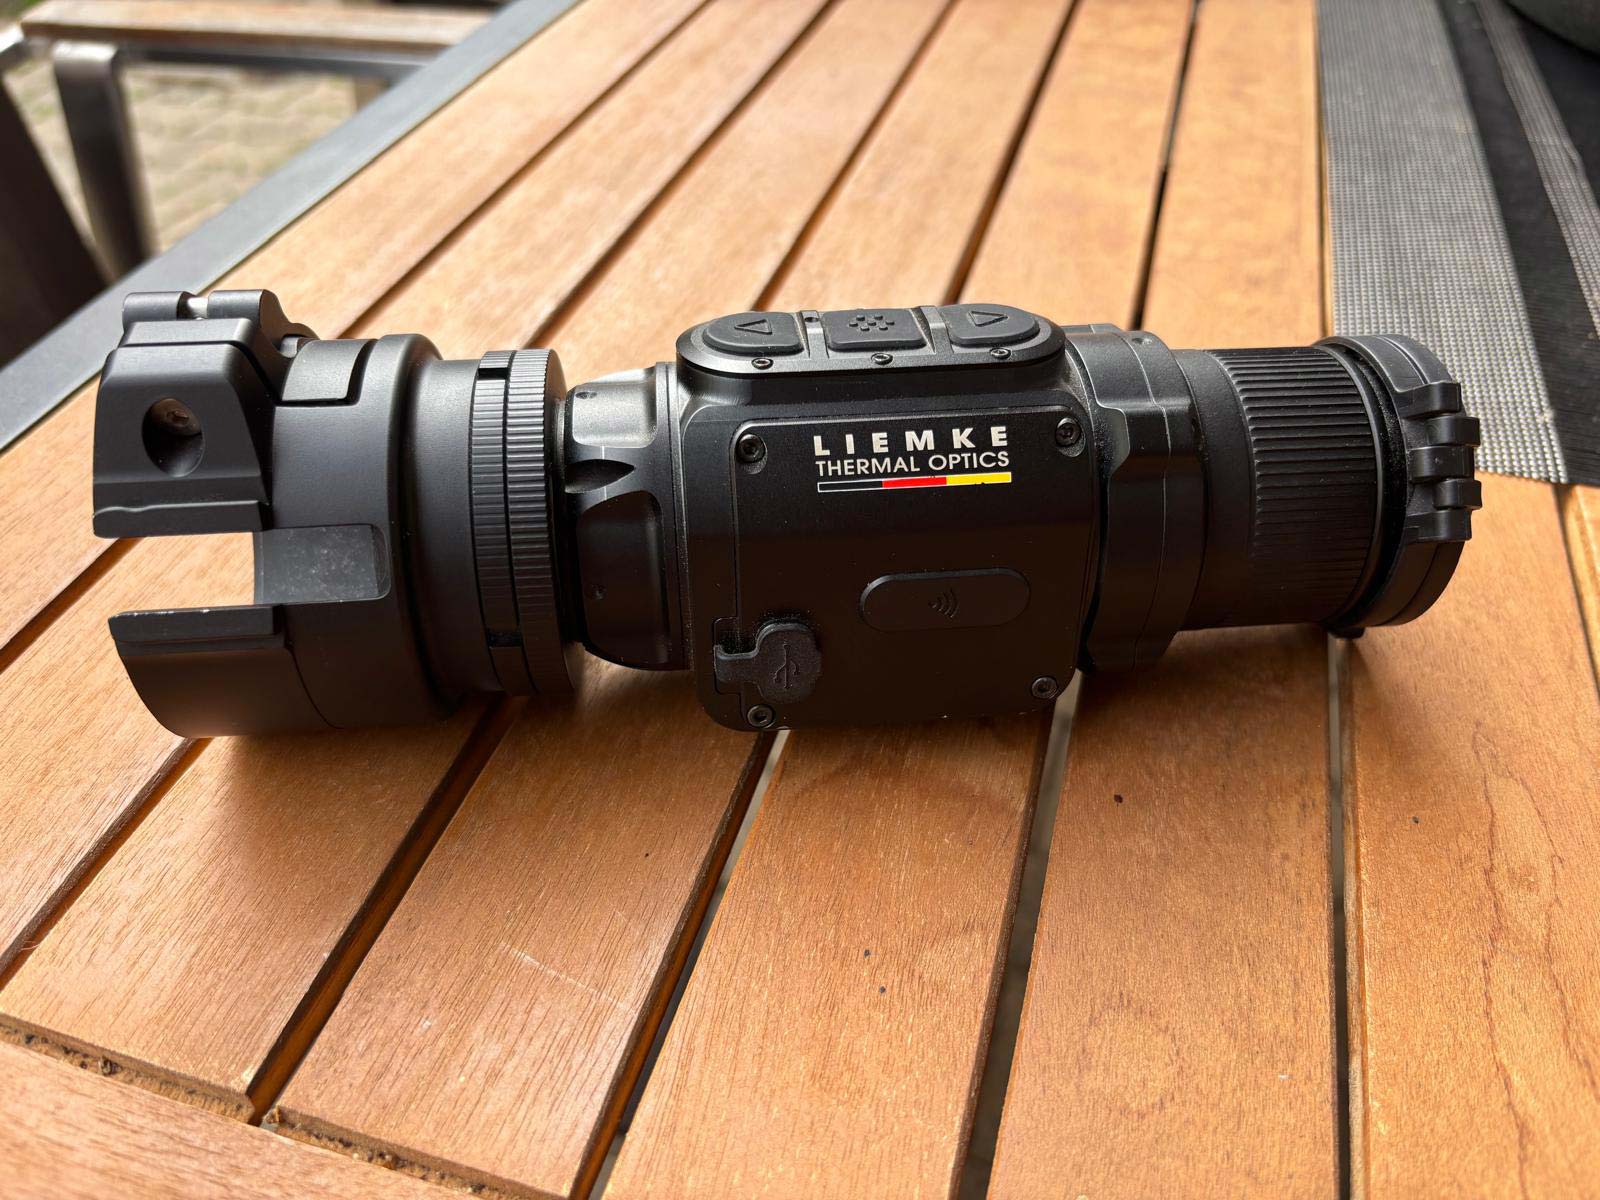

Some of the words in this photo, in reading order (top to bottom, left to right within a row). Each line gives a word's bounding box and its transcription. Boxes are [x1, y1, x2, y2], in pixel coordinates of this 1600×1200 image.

[813, 426, 1008, 456] LIEMKE
[815, 455, 920, 477] THERMAL
[928, 451, 1010, 471] OPTICS
